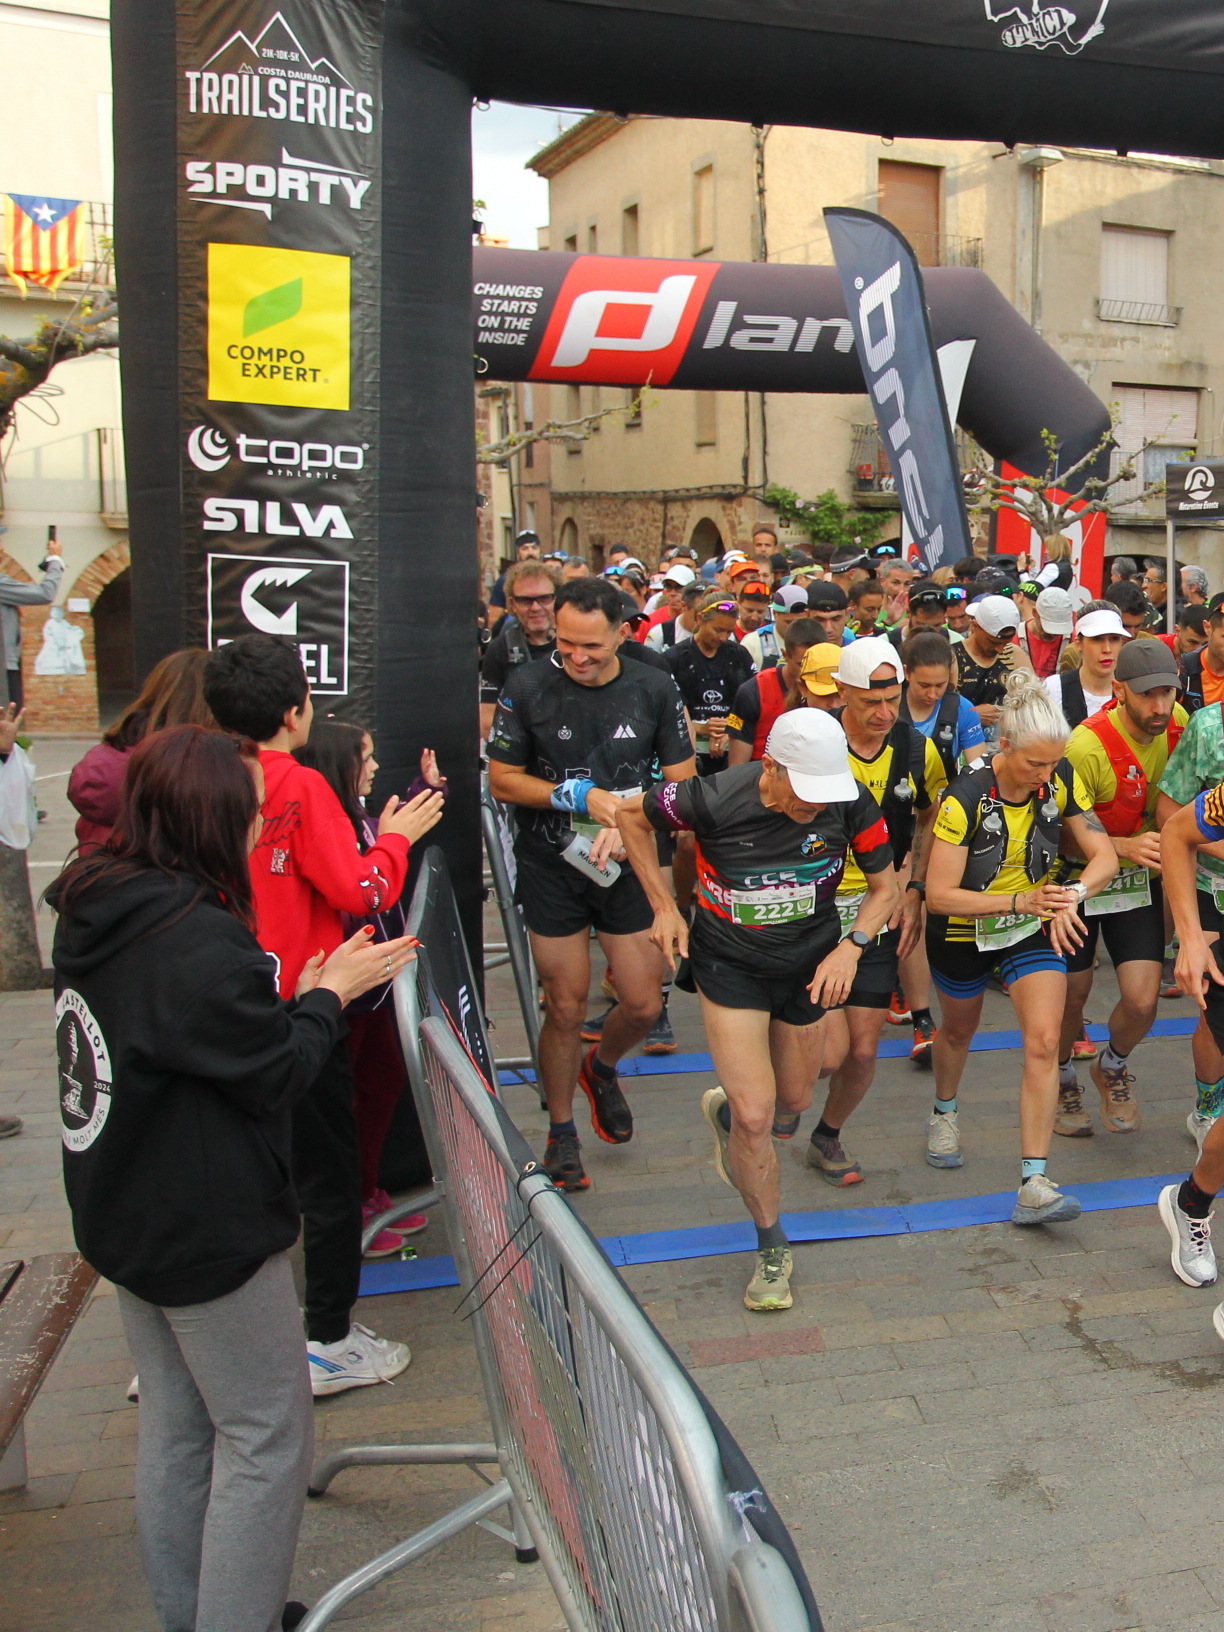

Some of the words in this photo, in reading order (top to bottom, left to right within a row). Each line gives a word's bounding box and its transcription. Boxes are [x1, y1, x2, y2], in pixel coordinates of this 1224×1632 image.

[257, 66, 287, 78] COSTA
[287, 69, 331, 85] DAURADA
[185, 71, 374, 135] TRAILSERIES
[185, 161, 373, 210] SPORTY
[473, 281, 544, 299] CHANGES
[480, 298, 539, 315] STARTS
[477, 315, 501, 329] ON
[503, 316, 533, 332] THE
[477, 331, 528, 346] INSIDE
[226, 344, 305, 365] COMPO
[241, 362, 322, 383] EXPERT
[236, 433, 365, 471] topo
[266, 468, 338, 481] athletic
[202, 496, 355, 540] SILVA
[577, 850, 612, 879] MAUREN
[753, 901, 796, 921] 222
[93, 1080, 111, 1093] 2024
